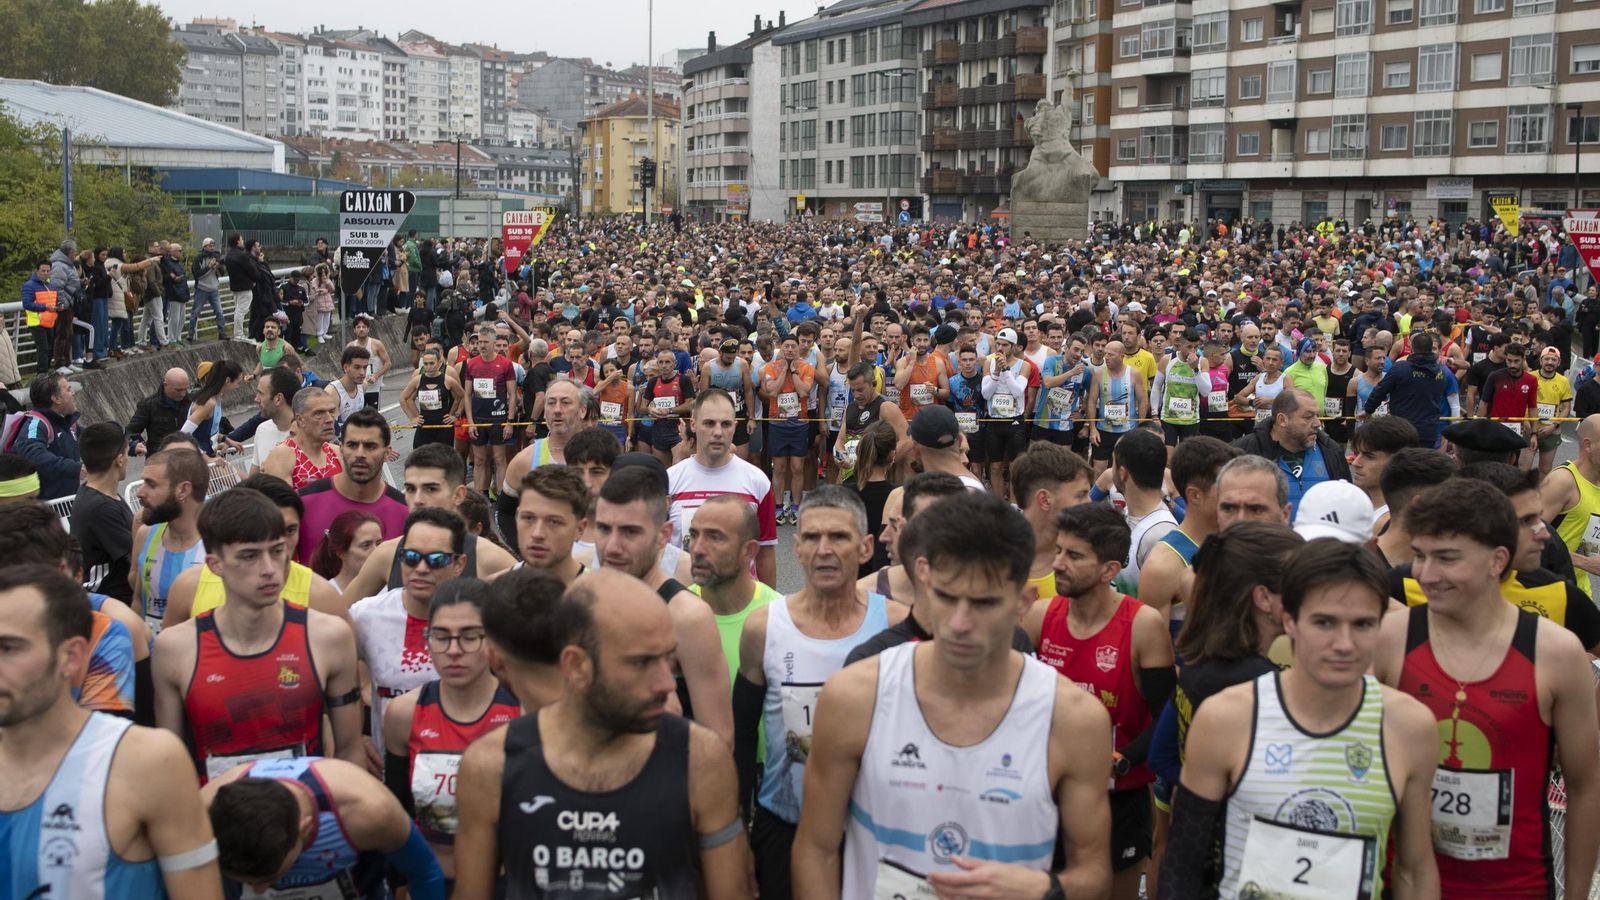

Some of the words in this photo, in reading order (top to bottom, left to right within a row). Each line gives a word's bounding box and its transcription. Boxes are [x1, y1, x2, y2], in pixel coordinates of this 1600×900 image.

[398, 192, 405, 212] 1
[344, 218, 396, 226] ABSOLUTA
[536, 212, 542, 224] 2
[532, 844, 550, 868] O
[556, 846, 645, 870] BARCO
[1292, 856, 1312, 885] 2
